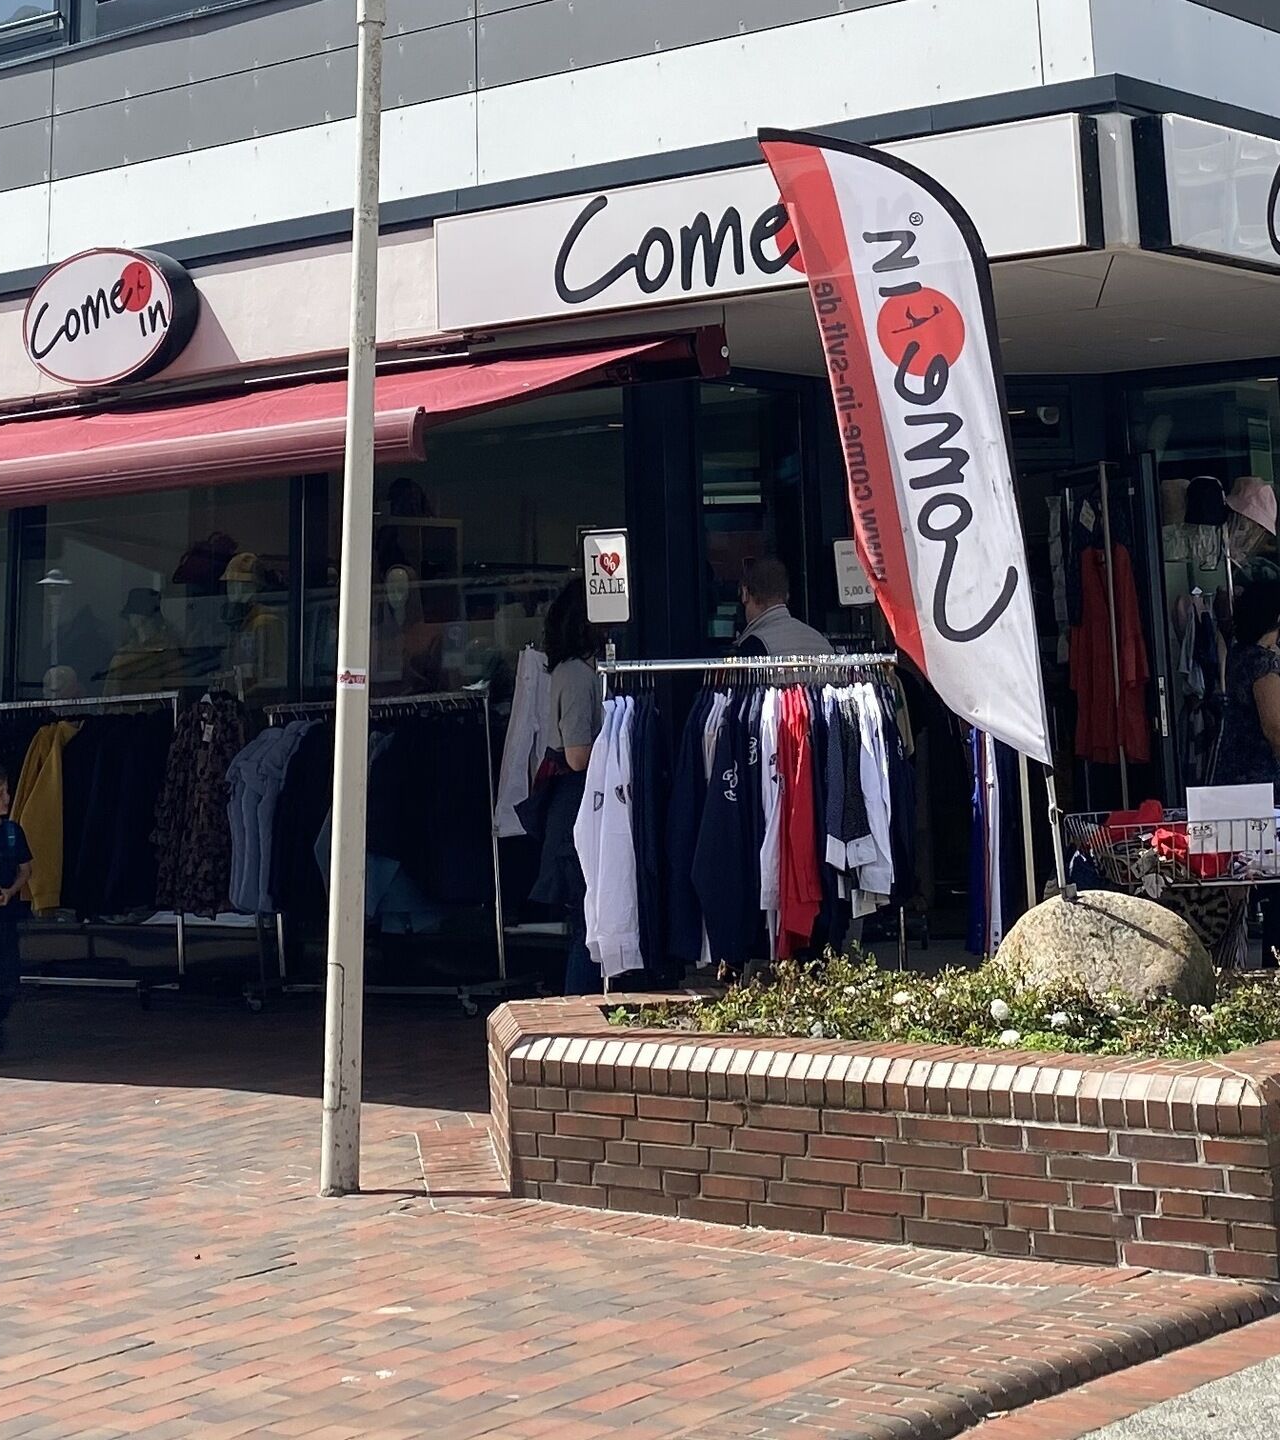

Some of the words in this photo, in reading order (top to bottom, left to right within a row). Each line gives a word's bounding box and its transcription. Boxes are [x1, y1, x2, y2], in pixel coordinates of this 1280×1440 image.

[554, 195, 801, 304] Come
[30, 279, 133, 360] Come
[139, 300, 168, 337] in
[591, 555, 598, 576] I
[589, 578, 626, 595] SALE
[844, 585, 864, 597] 5,00
